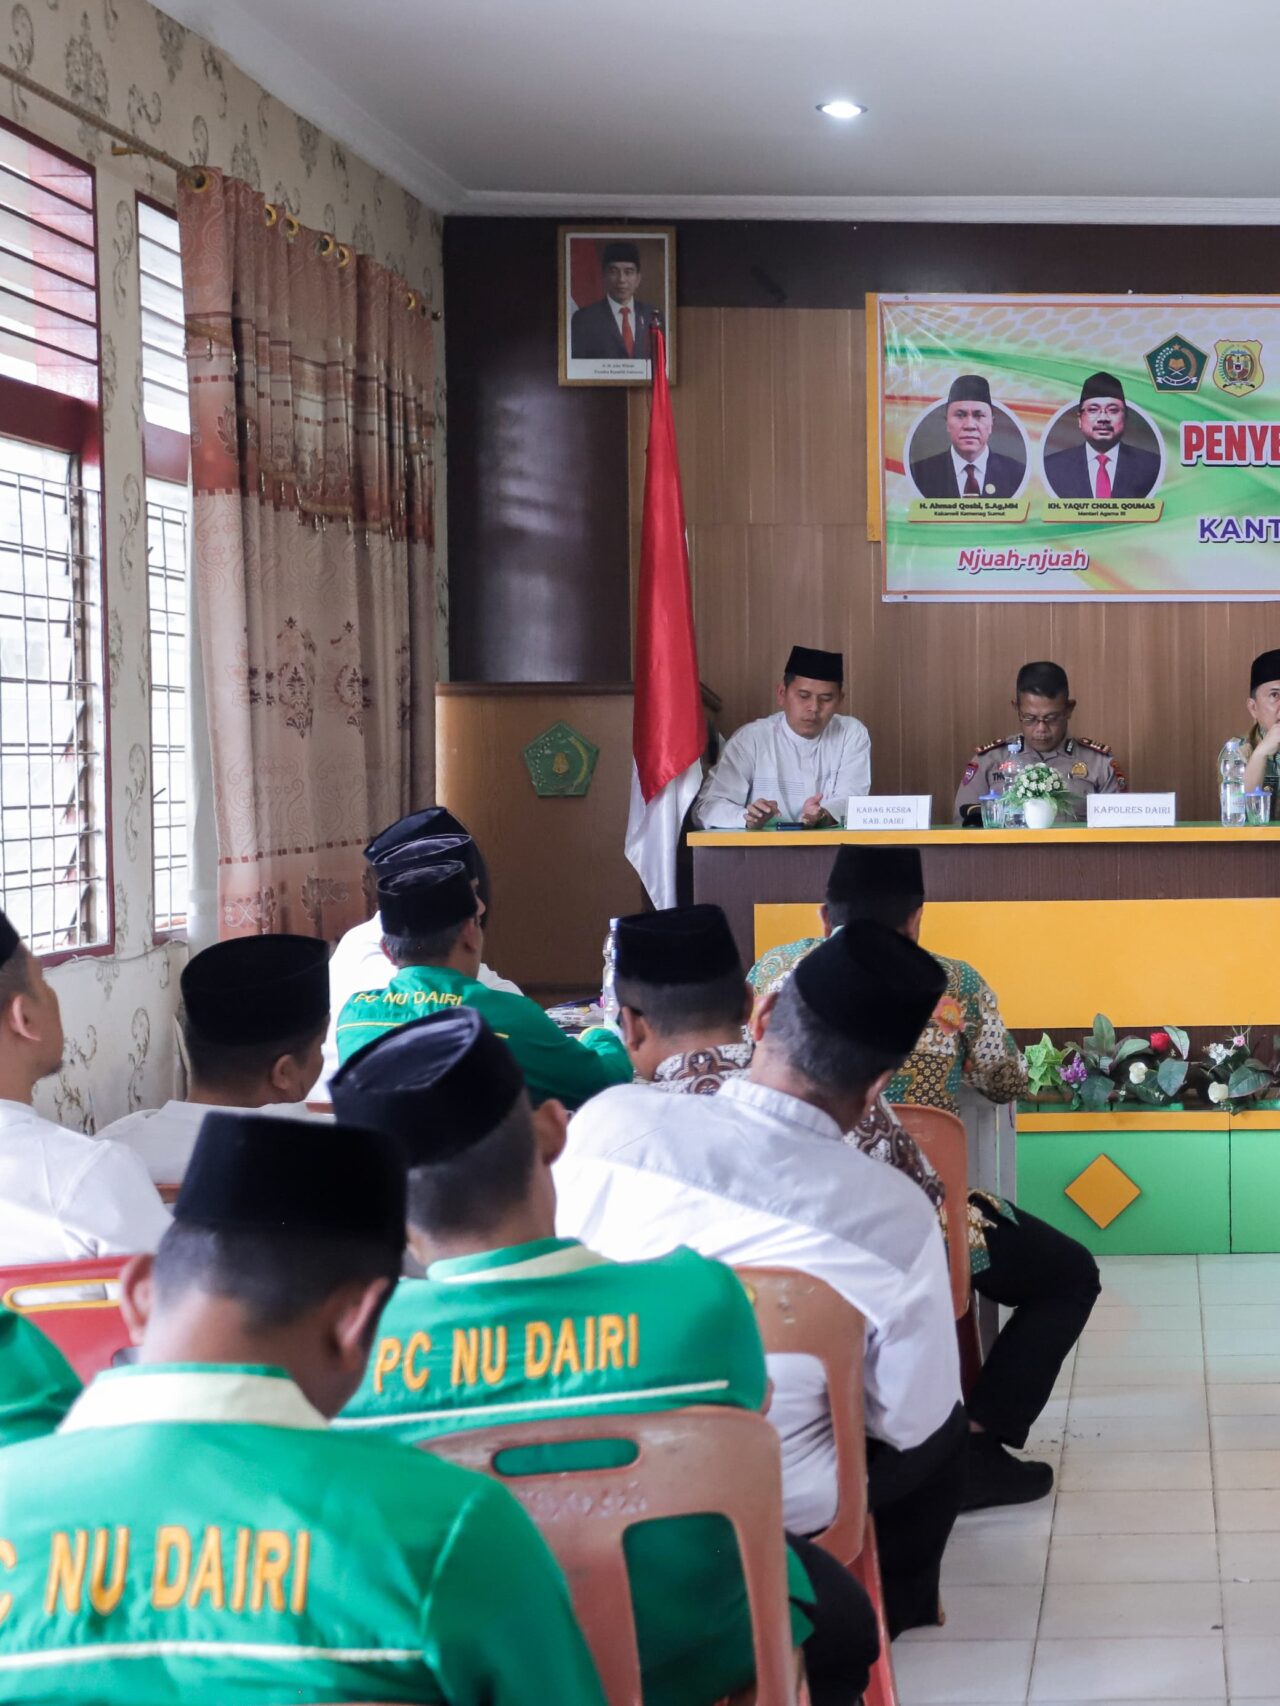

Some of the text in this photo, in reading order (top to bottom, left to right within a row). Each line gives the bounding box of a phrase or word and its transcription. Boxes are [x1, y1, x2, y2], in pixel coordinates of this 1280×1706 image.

[958, 548, 1088, 571] Njuah-njuah
[856, 806, 912, 814] KABAG KESRA
[1093, 806, 1171, 814] KAPOLRES DAIRI
[382, 992, 409, 1005] NU
[413, 990, 463, 1007] DAIRI
[373, 1313, 639, 1394] PC NU DAIRI
[45, 1525, 130, 1616] NU
[151, 1524, 311, 1615] DAIRI
